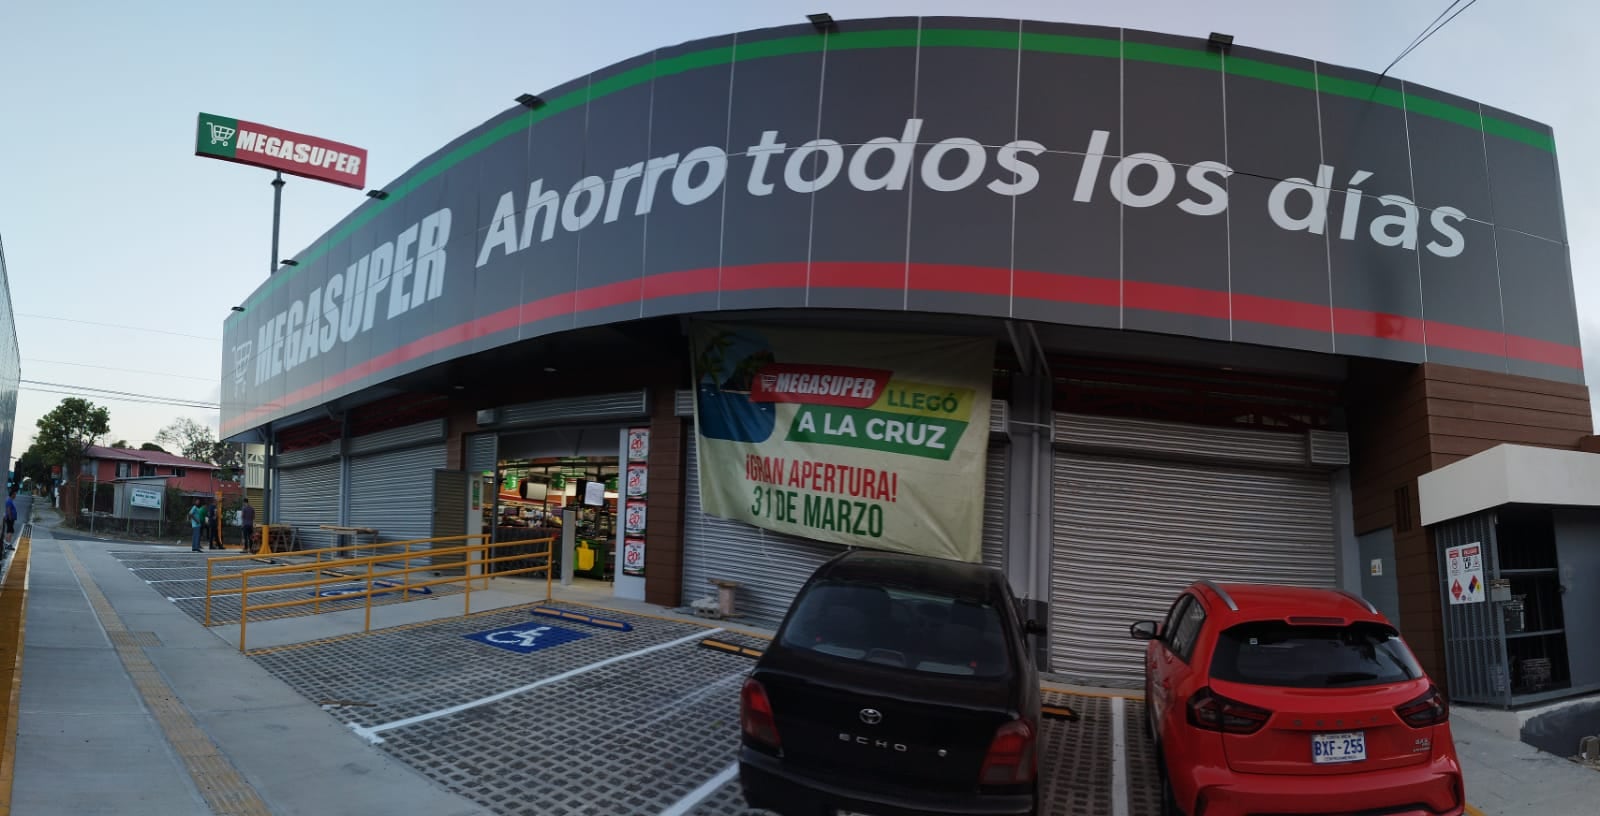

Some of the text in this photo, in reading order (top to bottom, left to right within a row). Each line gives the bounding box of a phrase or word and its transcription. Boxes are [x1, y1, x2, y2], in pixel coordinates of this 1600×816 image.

[236, 130, 361, 175] MEGASUPER
[475, 118, 1467, 268] Ahorro todos los días
[255, 207, 452, 387] MEGASUPER
[775, 373, 958, 413] MEGASUPER LLEGÓ
[797, 411, 947, 449] A LA CRUZ
[745, 454, 897, 502] ¡GRAN APERTURA!
[751, 485, 883, 538] 31 DE MARZO
[839, 733, 907, 751] ECHO
[1314, 738, 1364, 756] BXF-255
